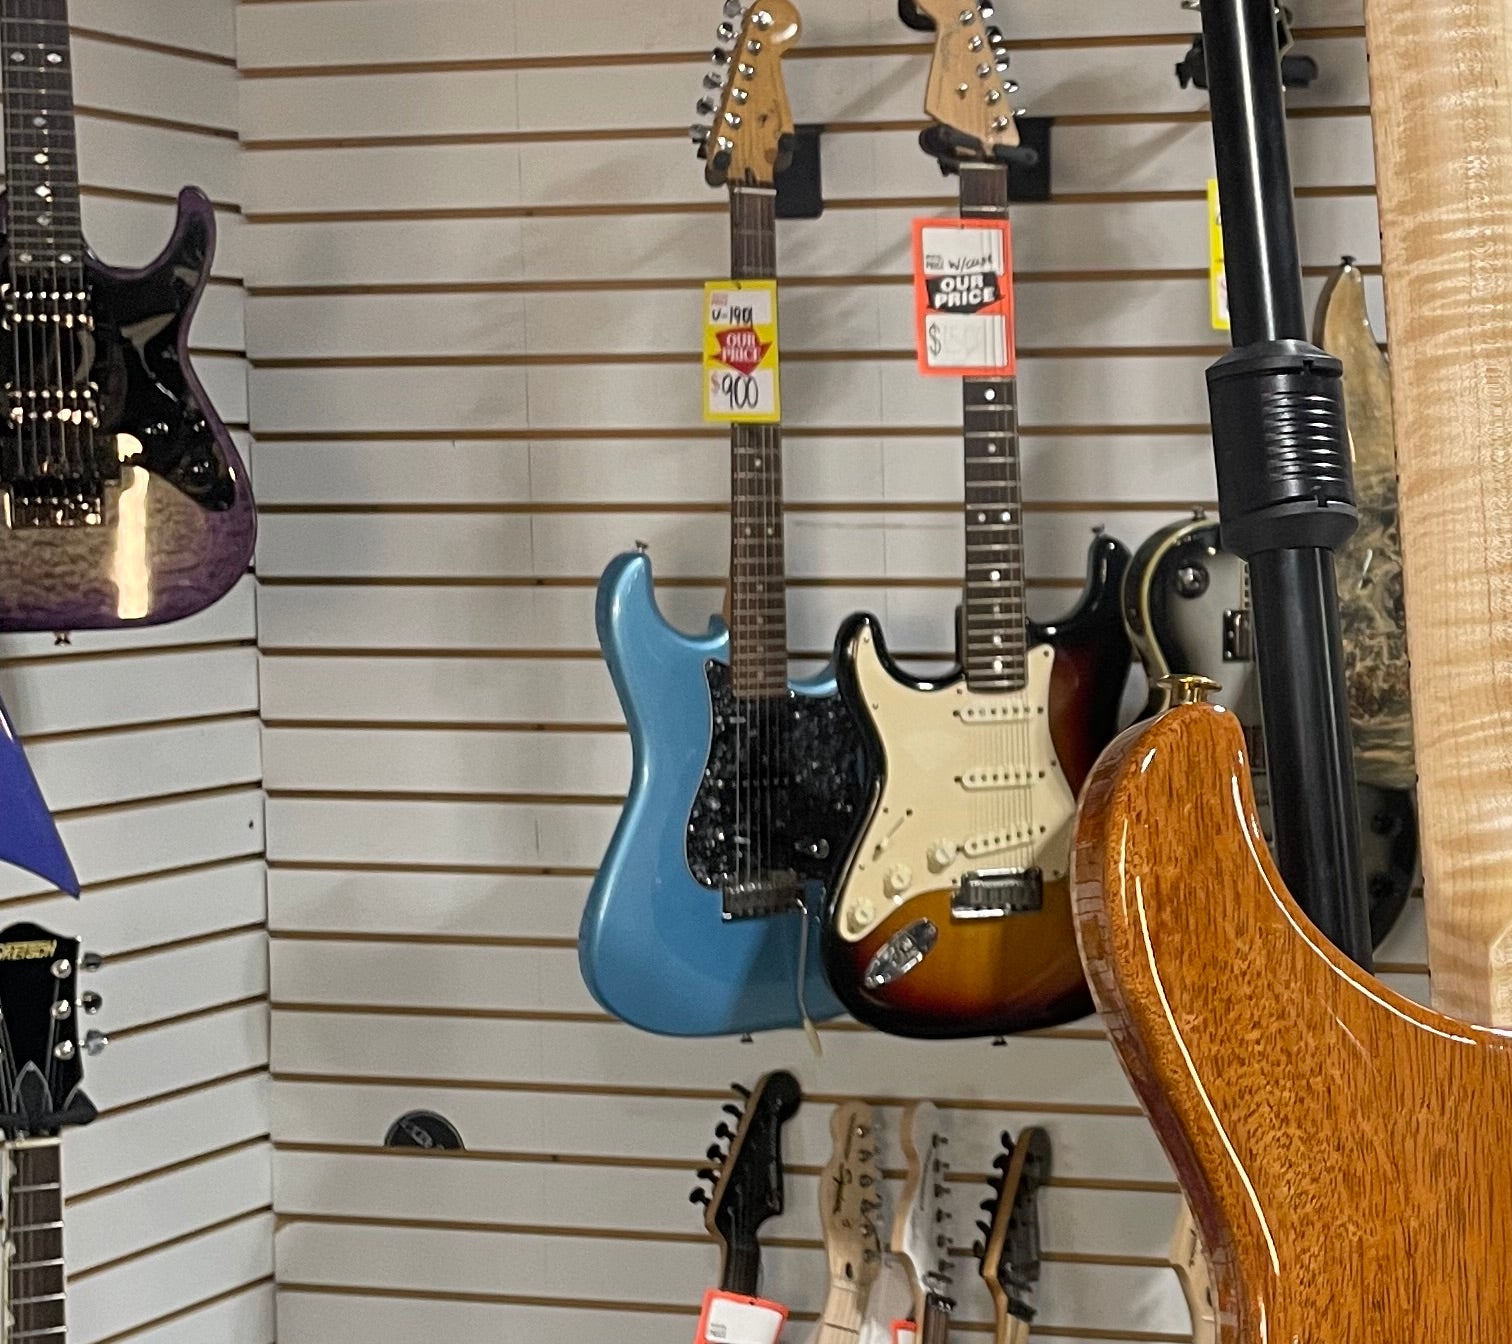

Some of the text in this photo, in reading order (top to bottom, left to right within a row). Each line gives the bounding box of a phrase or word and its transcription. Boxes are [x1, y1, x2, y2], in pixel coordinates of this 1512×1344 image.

[940, 274, 984, 293] OUR
[934, 287, 995, 309] PRICE
[726, 330, 756, 348] OUR
[722, 346, 761, 364] PRICE
[710, 371, 759, 411] $900
